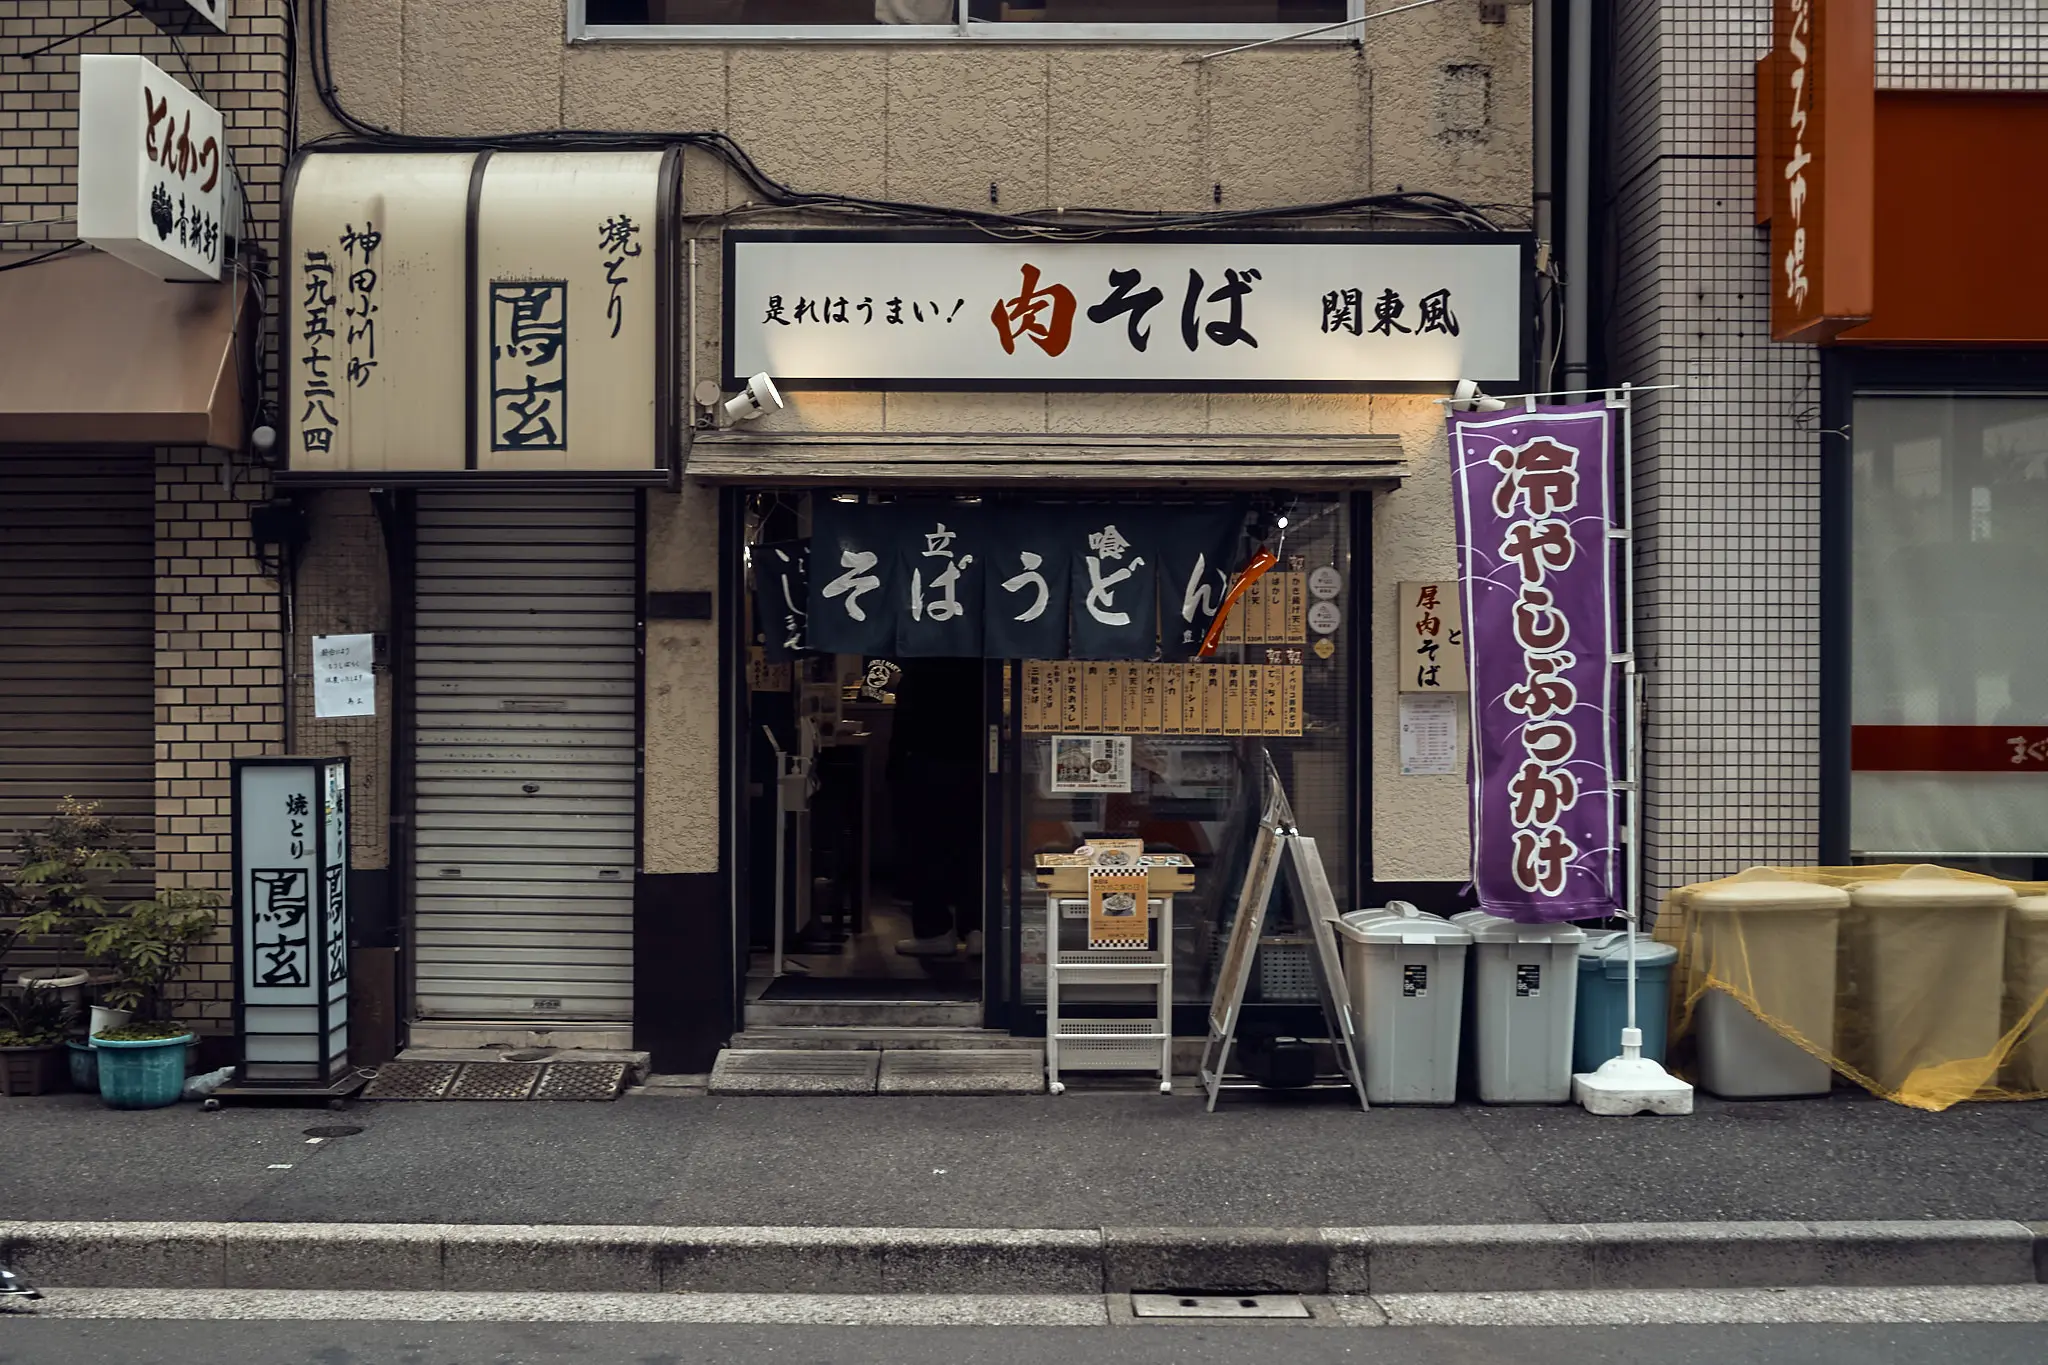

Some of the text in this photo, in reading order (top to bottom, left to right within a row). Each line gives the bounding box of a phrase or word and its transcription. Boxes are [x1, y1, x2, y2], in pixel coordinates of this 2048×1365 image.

[145, 86, 219, 193] とんかつ
[340, 222, 381, 387] 神田小川町
[600, 215, 641, 338] 焼とり
[762, 294, 965, 326] 是れはうまい！
[991, 263, 1263, 357] 肉そば
[1321, 288, 1460, 338] 関東風
[823, 550, 1228, 627] そばうどん
[1416, 585, 1440, 687] 厚肉そば
[1490, 436, 1580, 896] 冷やしぶっかけ
[286, 794, 308, 859] 焼とり
